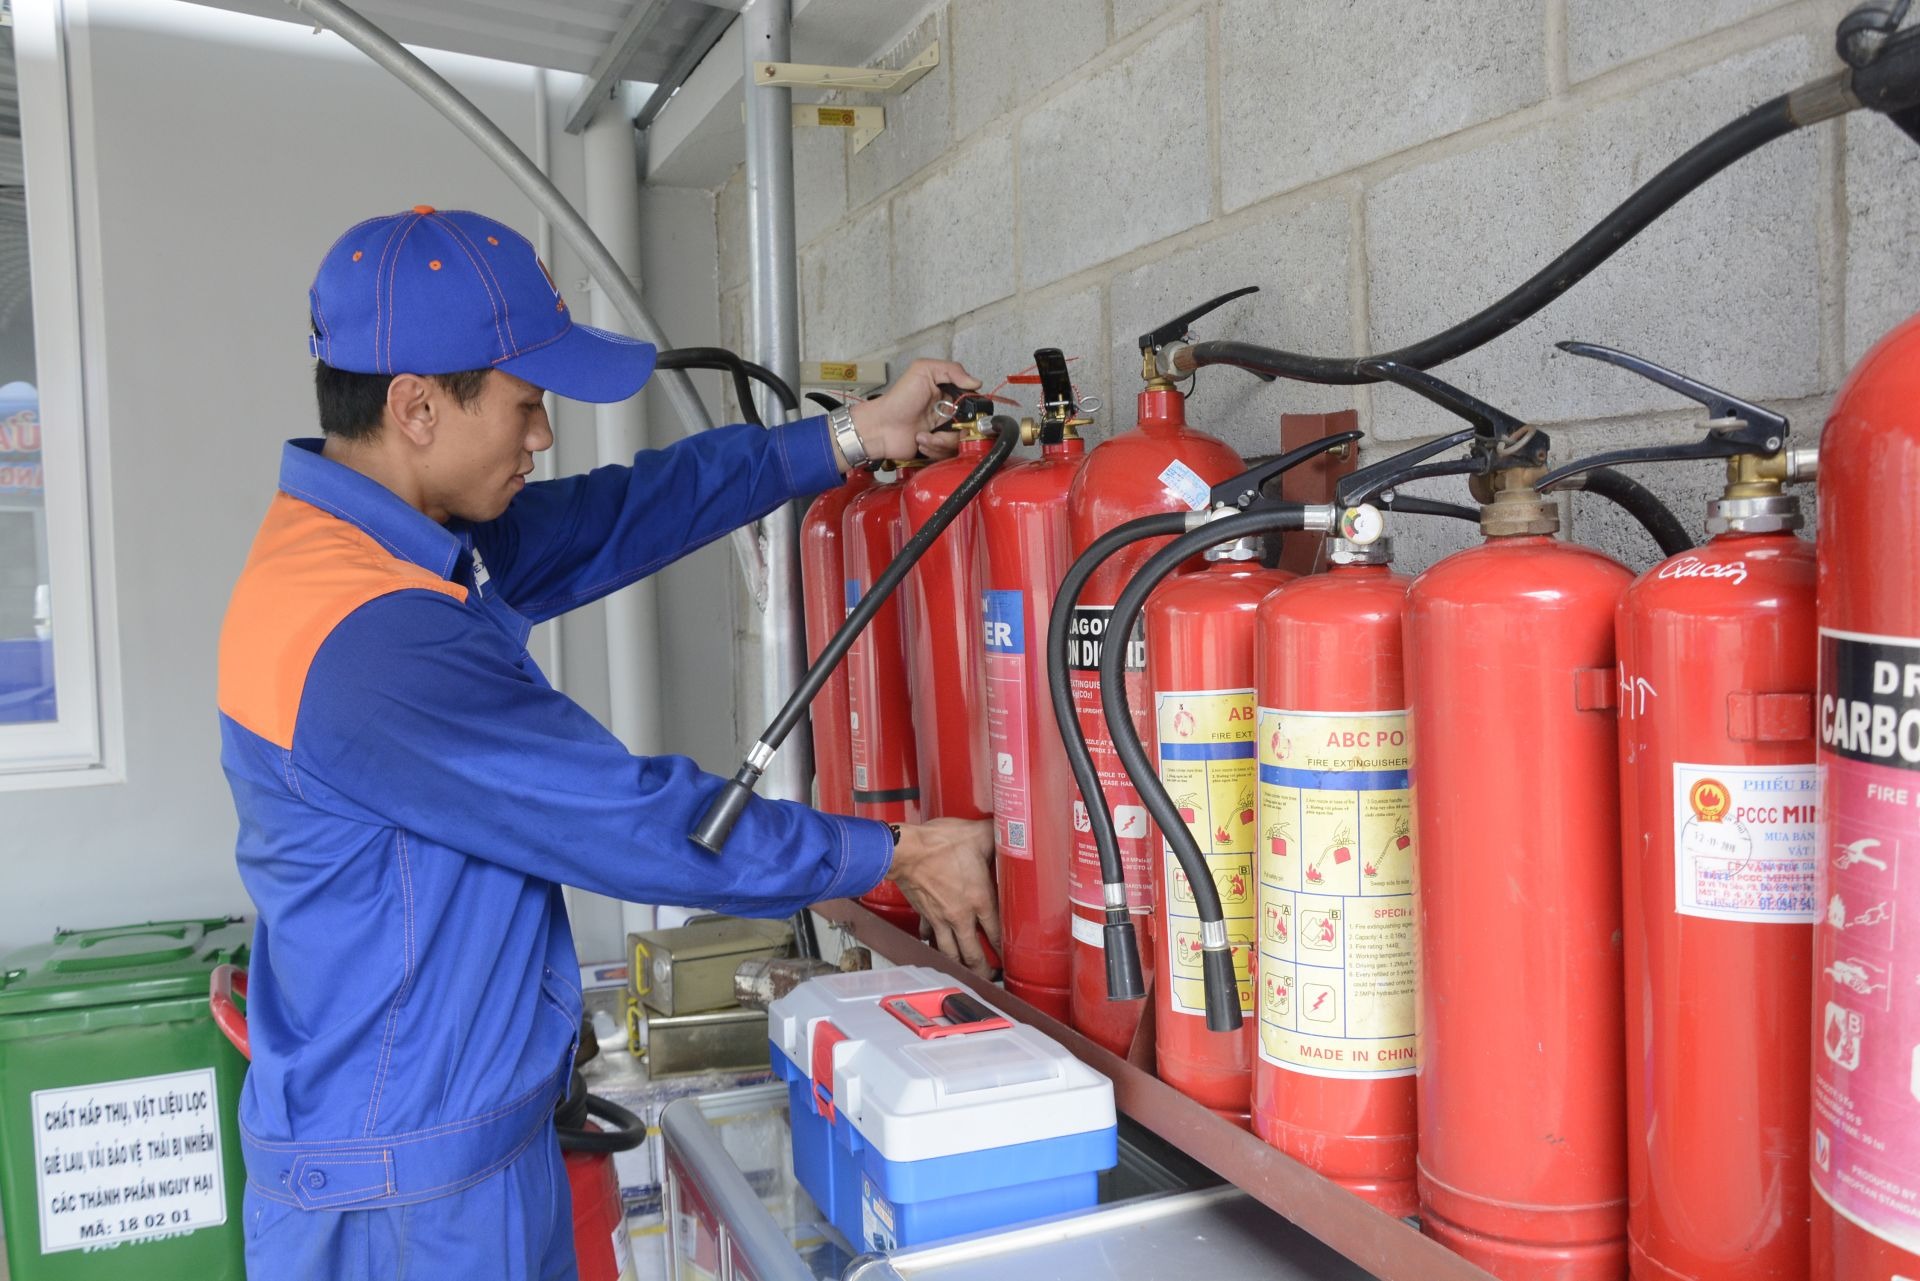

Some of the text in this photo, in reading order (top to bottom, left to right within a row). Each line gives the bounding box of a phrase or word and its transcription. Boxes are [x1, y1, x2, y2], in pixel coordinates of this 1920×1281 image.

[985, 622, 1013, 647] ER
[1069, 618, 1109, 636] AGO
[1212, 732, 1231, 740] FIRE
[1327, 731, 1405, 748] ABC PO
[1334, 758, 1408, 767] EXTINGUISHER
[1744, 776, 1795, 790] PHIẾU
[1867, 783, 1909, 805] FIRE
[1737, 807, 1778, 823] PCCC
[1765, 832, 1789, 841] MUA
[1283, 906, 1290, 915] A
[1332, 911, 1338, 919] B
[1285, 978, 1291, 986] C
[1849, 1015, 1859, 1033] B
[1300, 1044, 1344, 1062] MADE
[1353, 1050, 1369, 1062] IN
[186, 1091, 207, 1116] LỌC
[52, 1191, 76, 1214] CÁC
[159, 1176, 190, 1196] NGUY
[194, 1173, 213, 1196] HẠI
[1902, 1189, 1916, 1200] BY
[80, 1209, 190, 1239] MÃ: 18 02 01
